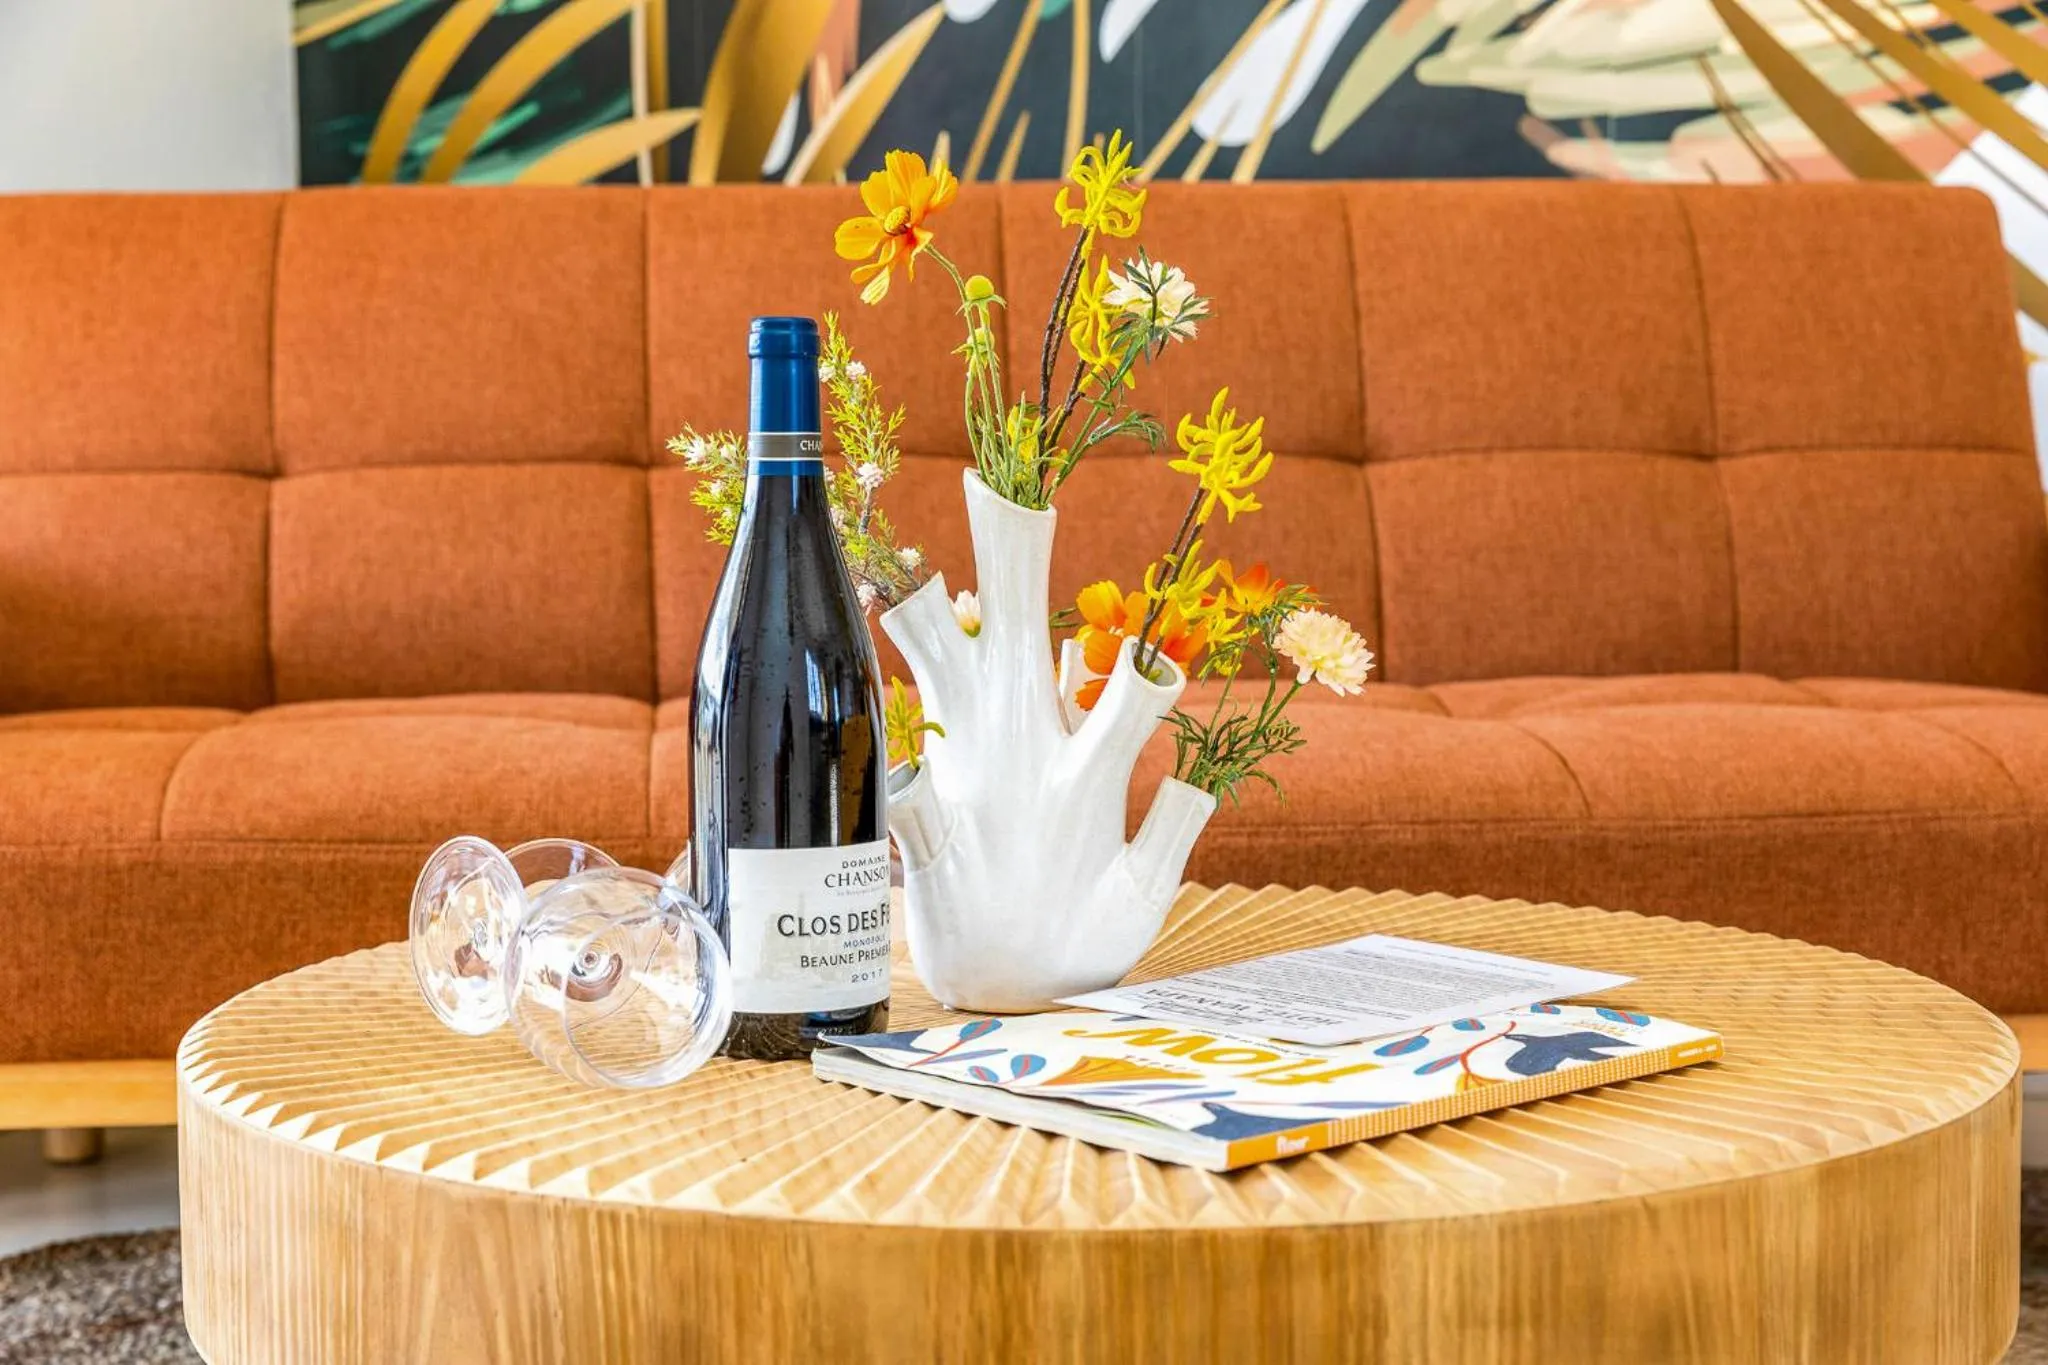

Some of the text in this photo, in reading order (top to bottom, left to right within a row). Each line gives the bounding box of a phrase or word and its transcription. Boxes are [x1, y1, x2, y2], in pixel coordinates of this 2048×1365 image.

[842, 854, 886, 869] DOMAINE
[777, 914, 841, 938] CLOS
[847, 908, 878, 933] DES
[800, 952, 854, 969] BEAUNE
[851, 968, 883, 983] 2017
